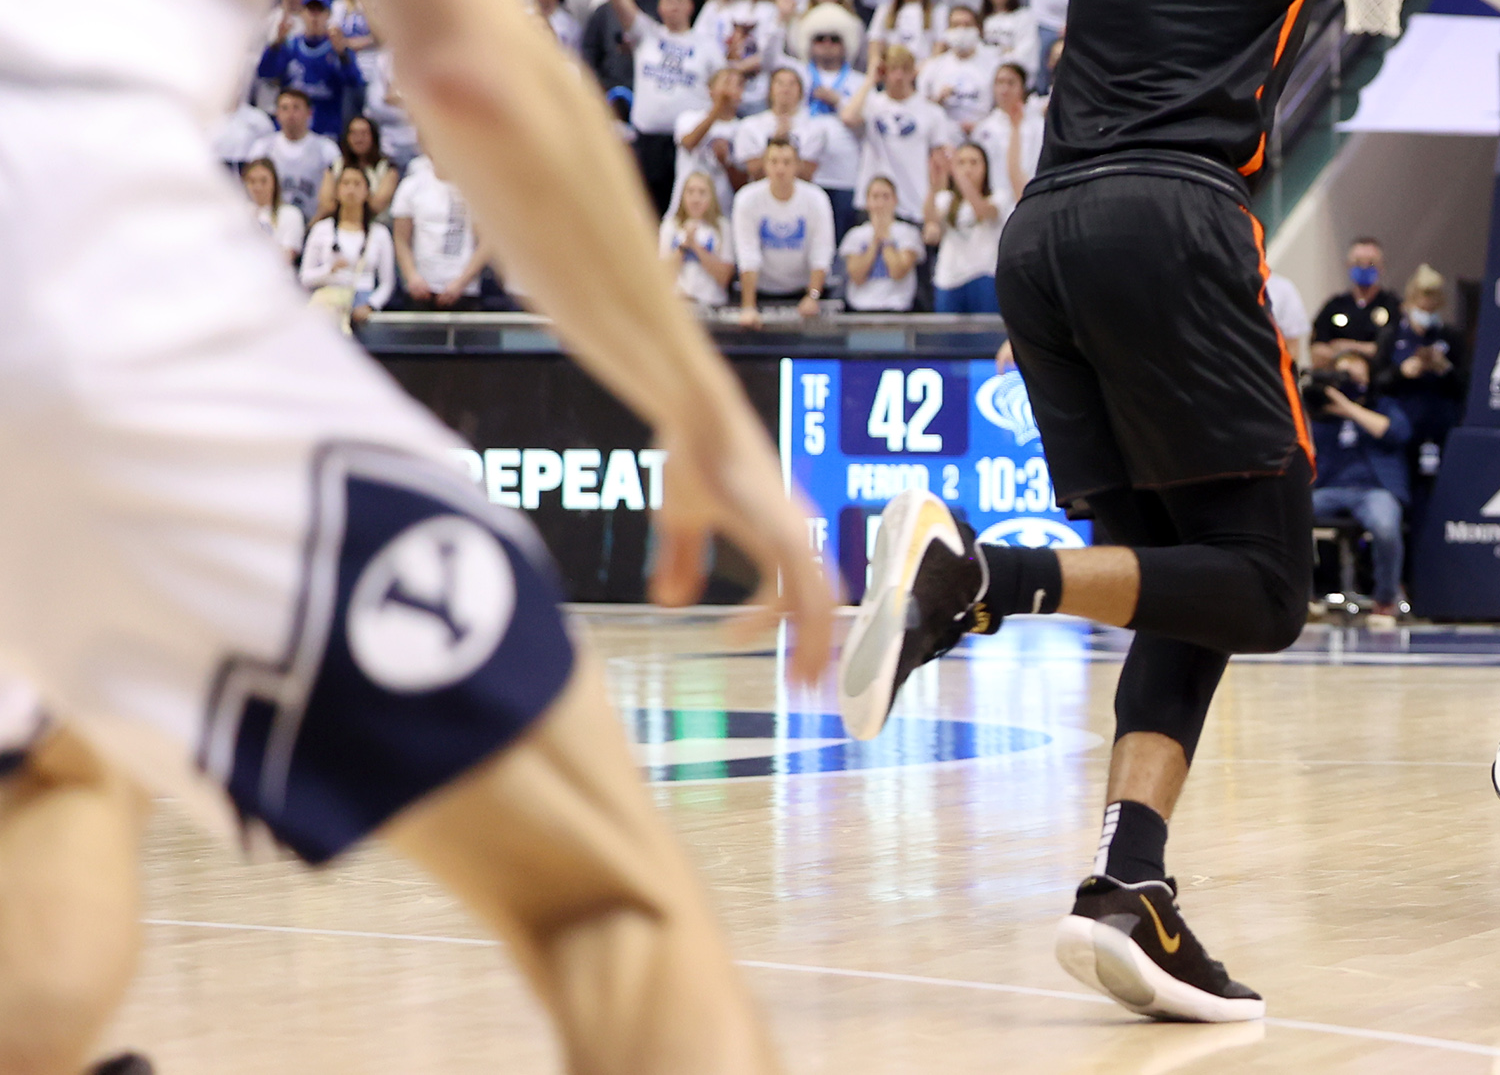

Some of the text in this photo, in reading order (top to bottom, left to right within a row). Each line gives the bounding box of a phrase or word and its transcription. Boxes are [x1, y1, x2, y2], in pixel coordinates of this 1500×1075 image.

[801, 373, 831, 411] TF
[867, 368, 943, 453] 42
[803, 411, 826, 456] 5
[942, 464, 960, 500] 2
[975, 456, 1060, 513] 10:3
